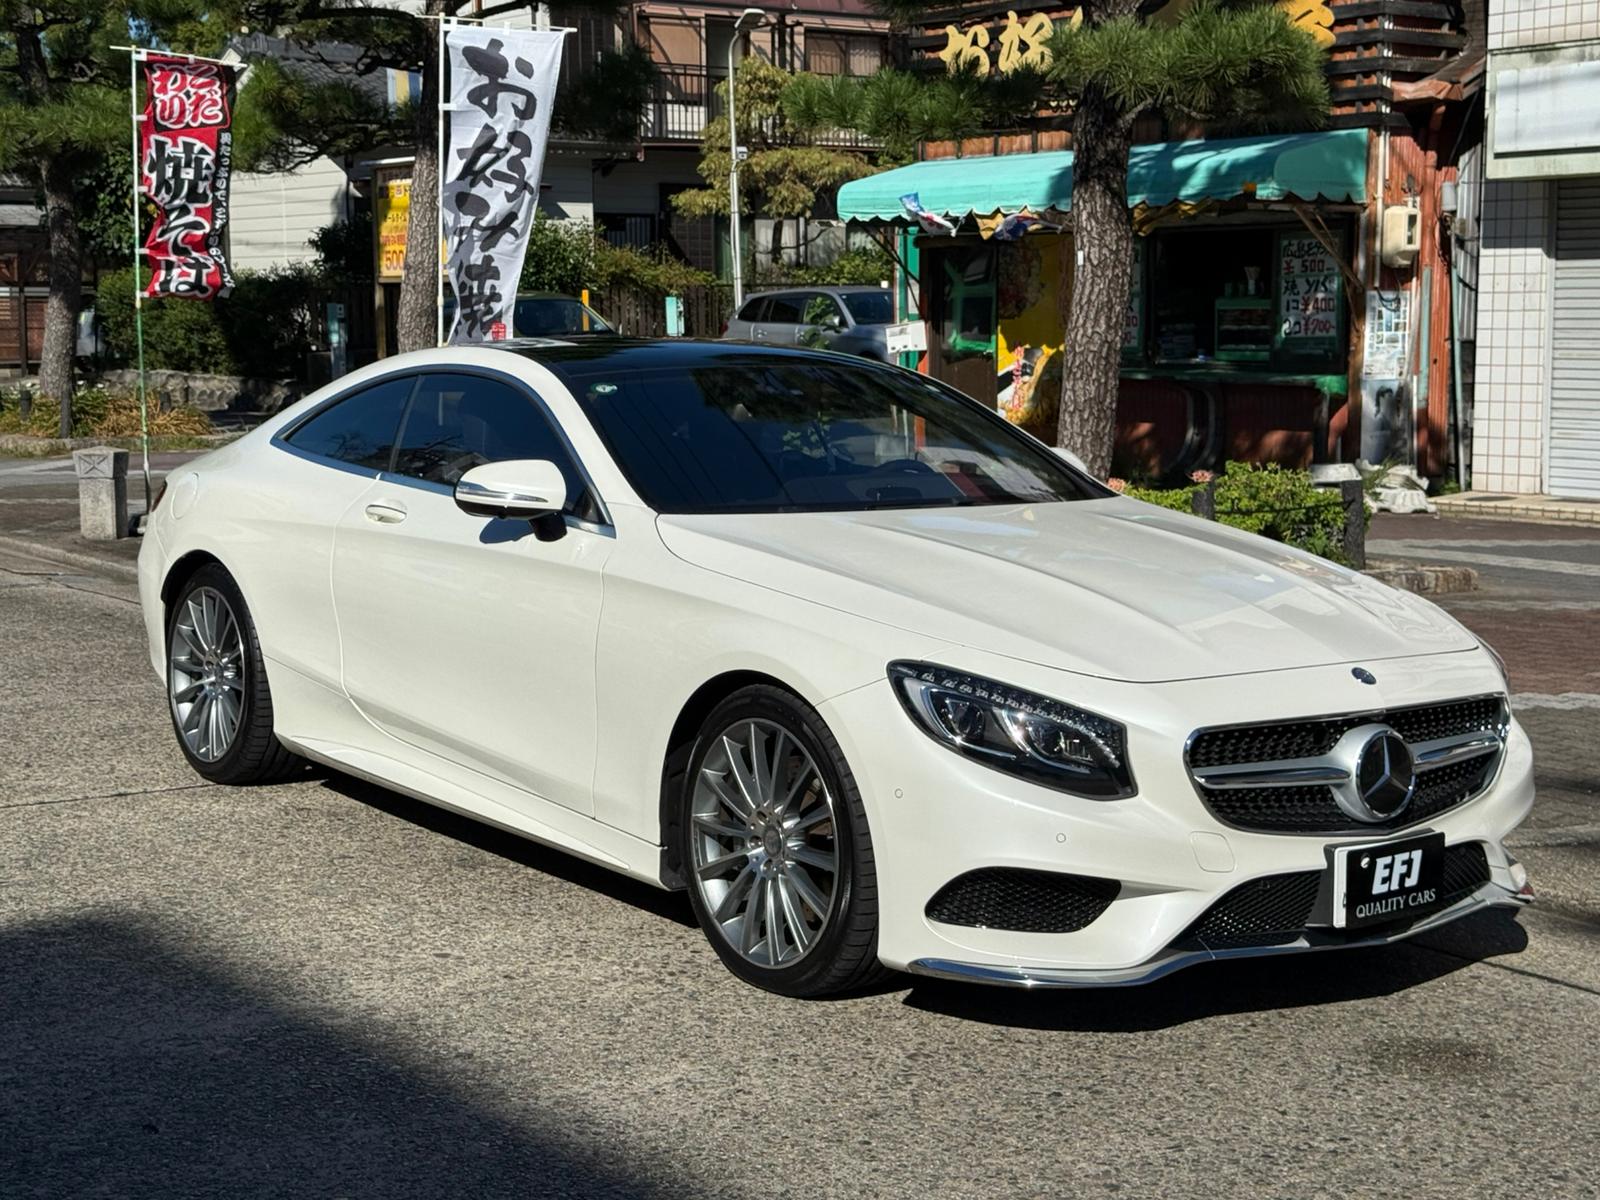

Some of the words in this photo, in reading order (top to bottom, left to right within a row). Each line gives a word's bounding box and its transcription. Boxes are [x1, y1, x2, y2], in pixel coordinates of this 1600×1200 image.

[939, 6, 1083, 79] お好
[145, 135, 216, 297] 焼そば
[1372, 849, 1423, 895] EFJ
[1356, 896, 1406, 918] QUALITY
[1408, 888, 1436, 907] CARS
